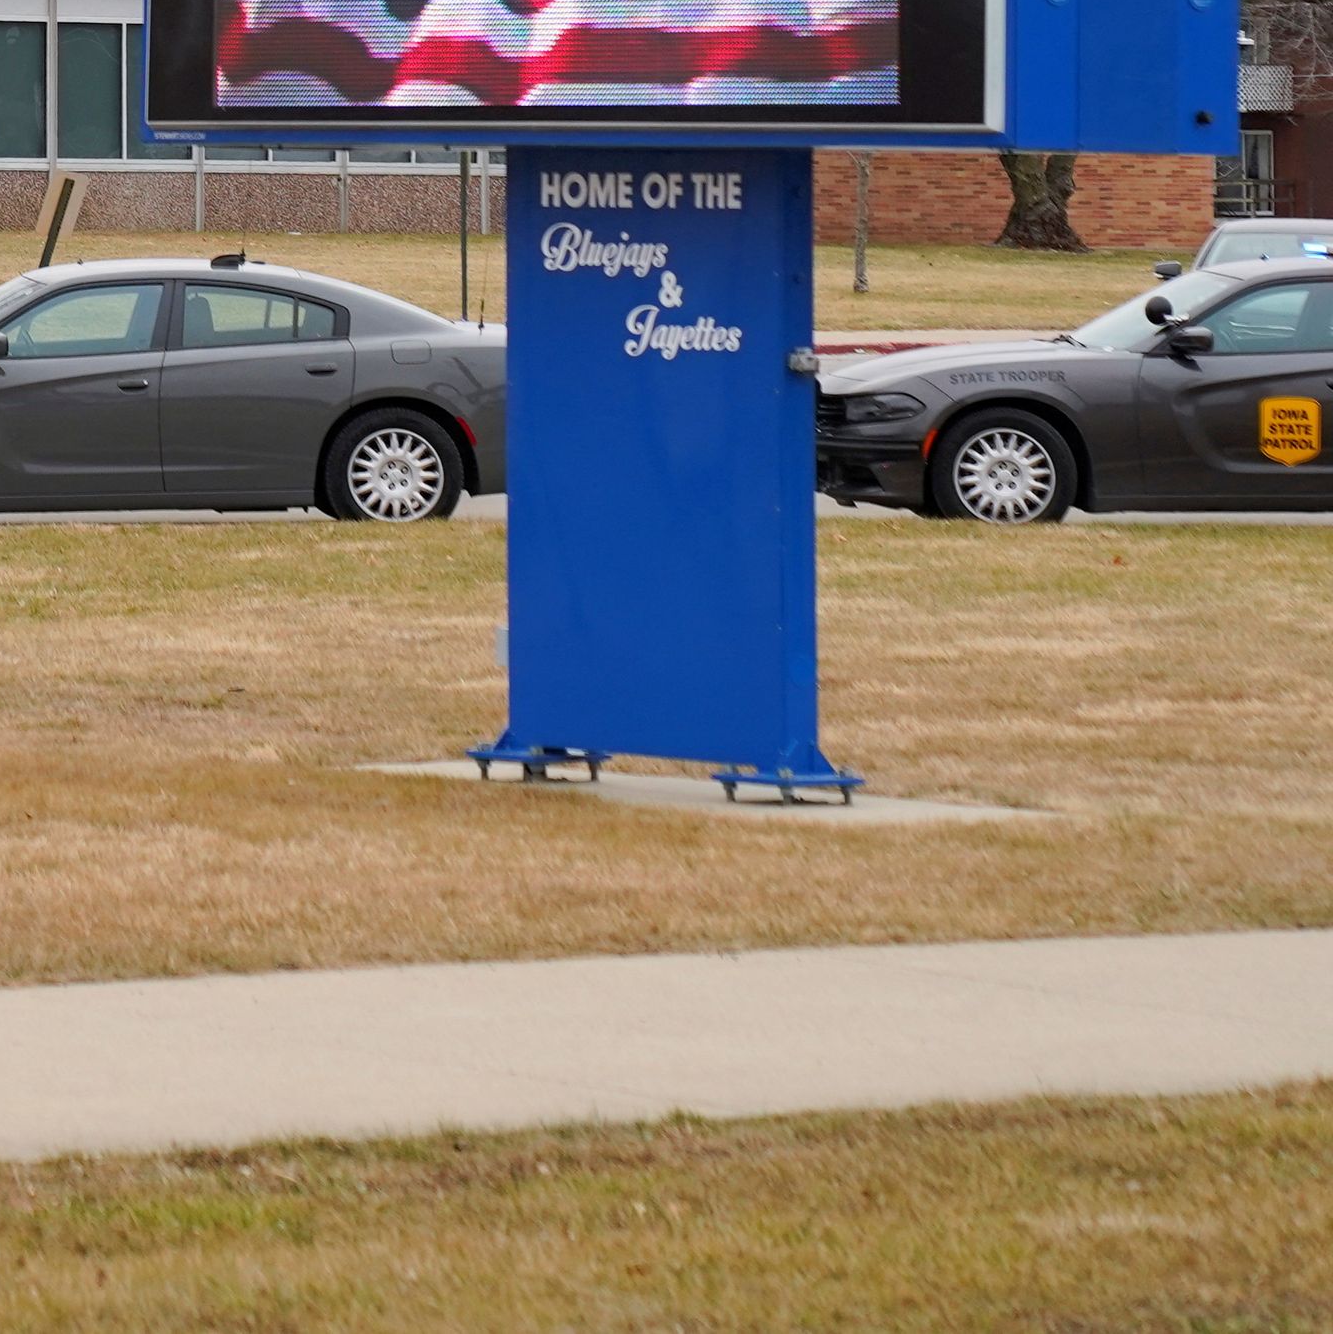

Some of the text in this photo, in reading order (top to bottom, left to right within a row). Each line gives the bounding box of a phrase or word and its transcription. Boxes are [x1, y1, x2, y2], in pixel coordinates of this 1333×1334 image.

[540, 171, 742, 210] HOME OF THE
[540, 221, 669, 278] Bluejays
[658, 270, 683, 308] &
[624, 304, 743, 361] Jayettes
[949, 370, 1067, 385] STATE TROOPER
[1272, 409, 1309, 421] IOWA
[1268, 424, 1313, 436] STATE
[1263, 438, 1316, 451] PATROL
